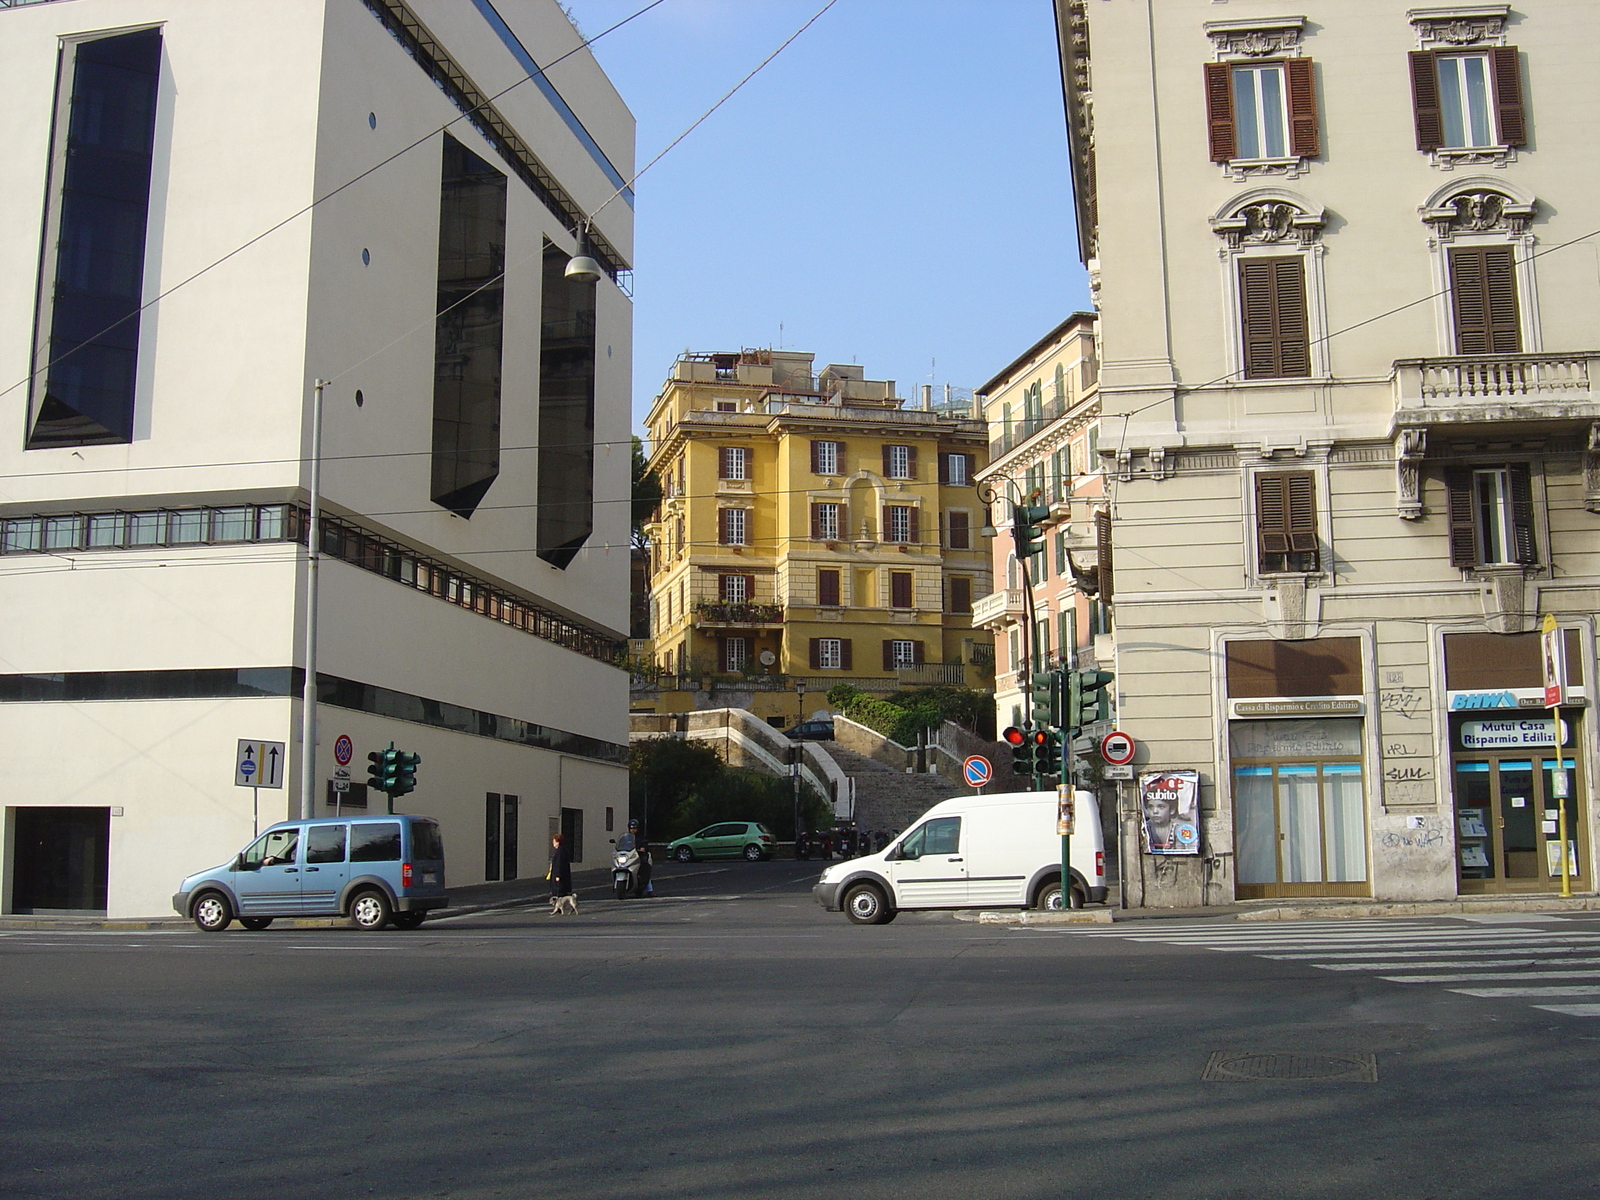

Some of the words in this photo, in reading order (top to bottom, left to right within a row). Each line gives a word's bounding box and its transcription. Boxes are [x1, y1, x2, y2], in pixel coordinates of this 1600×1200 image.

[1451, 692, 1505, 709] BHW
[1235, 704, 1256, 712] Cassa
[1256, 703, 1264, 711] di
[1264, 702, 1300, 713] Risparmio
[1305, 702, 1331, 710] Credito
[1331, 701, 1359, 709] Edilizio
[1481, 721, 1516, 732] Mutui
[1519, 721, 1545, 731] Casa
[1464, 734, 1519, 747] Risparmio
[1522, 732, 1557, 743] Edilizi
[1146, 789, 1177, 800] subito
